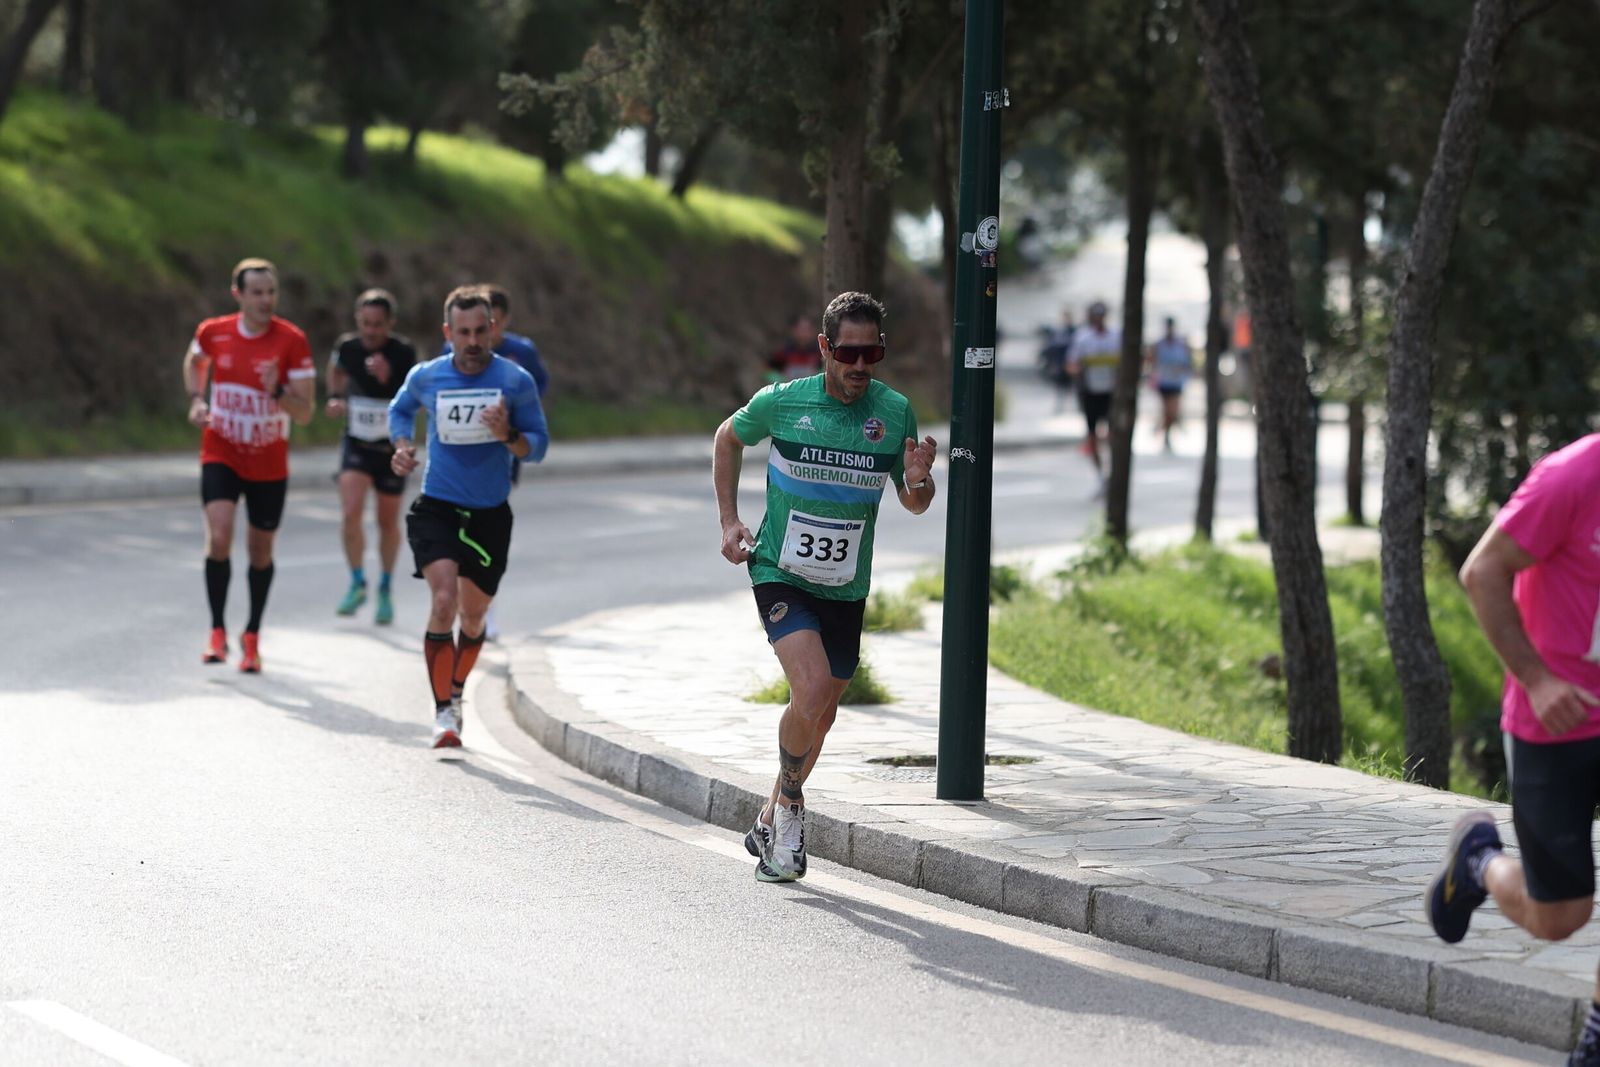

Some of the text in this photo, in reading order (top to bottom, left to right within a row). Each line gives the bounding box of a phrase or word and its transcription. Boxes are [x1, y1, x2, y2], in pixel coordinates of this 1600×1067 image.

[800, 447, 875, 469] ATLETISMO
[788, 464, 883, 488] TORREMOLINOS
[796, 533, 849, 562] 333
